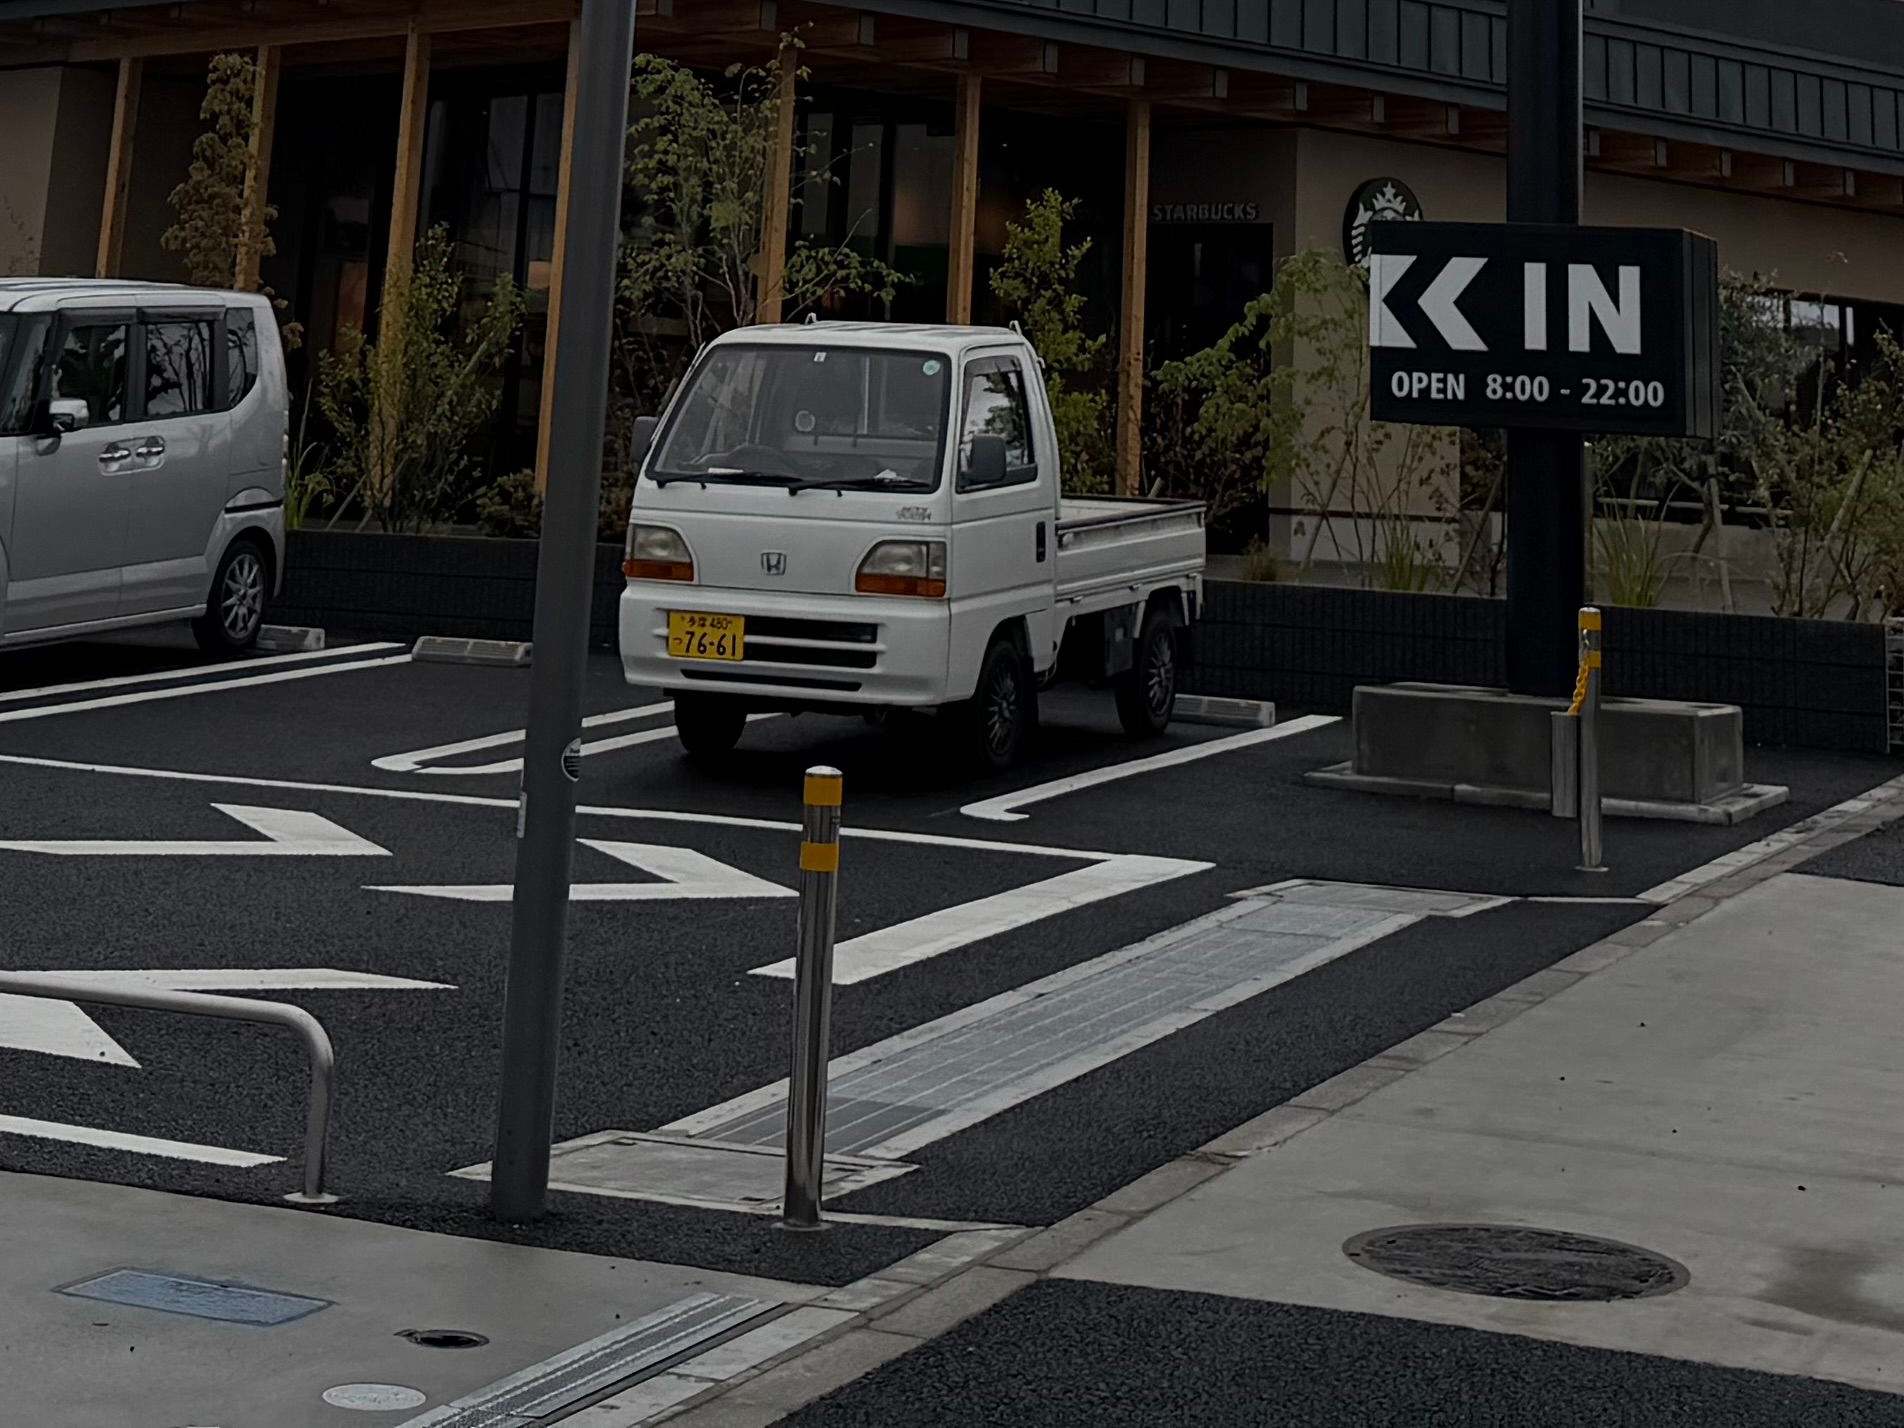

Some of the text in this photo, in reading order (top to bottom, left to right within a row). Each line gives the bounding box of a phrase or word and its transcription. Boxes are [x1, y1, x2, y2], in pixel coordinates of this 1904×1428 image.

[1151, 202, 1258, 221] STARBUCKS
[1524, 261, 1642, 355] IN
[1390, 370, 1466, 401] OPEN
[1485, 373, 1550, 402] 8:00
[1580, 377, 1665, 408] 22:00
[684, 630, 736, 657] 76-61
